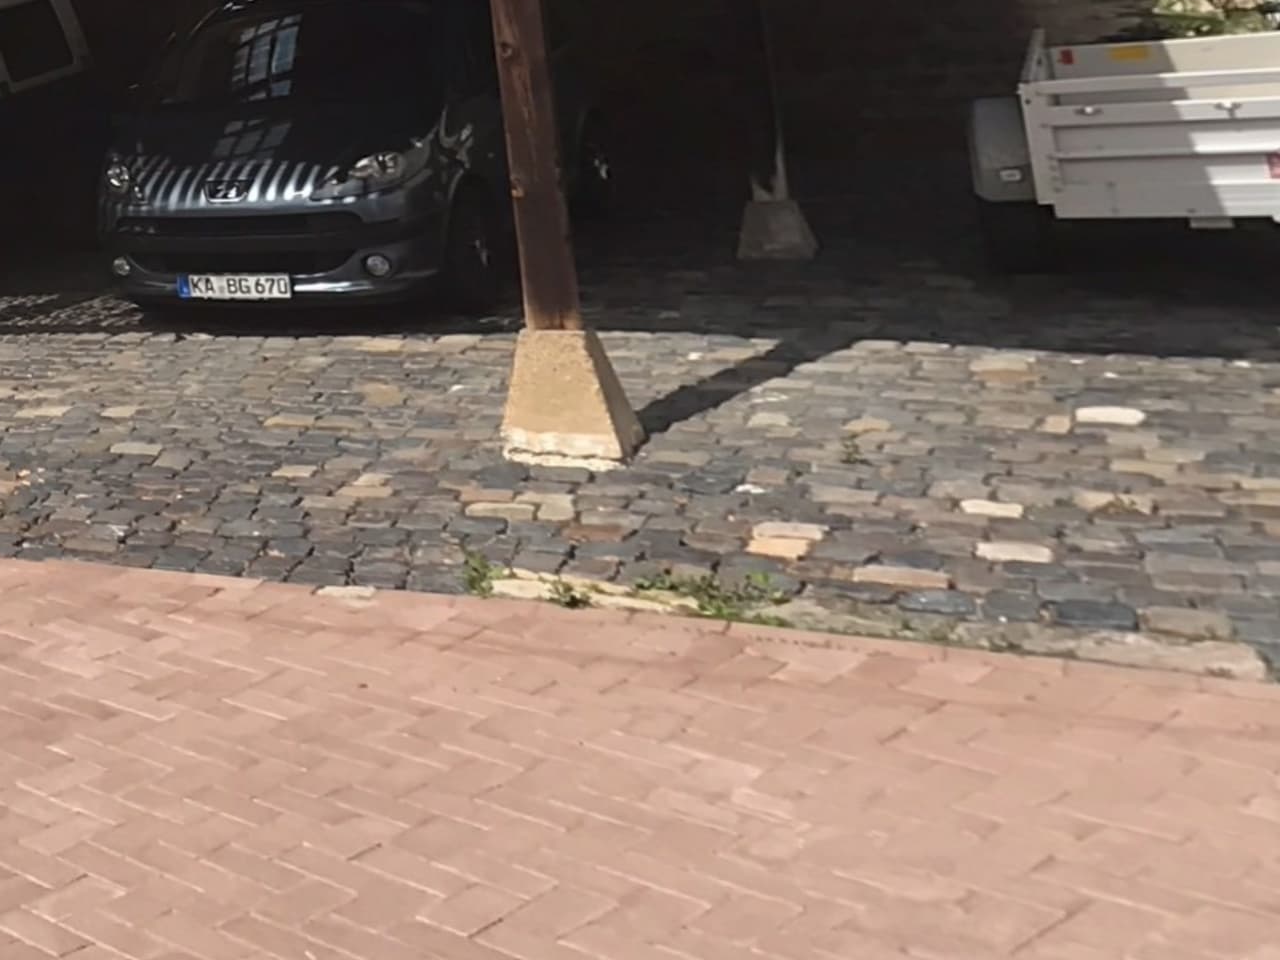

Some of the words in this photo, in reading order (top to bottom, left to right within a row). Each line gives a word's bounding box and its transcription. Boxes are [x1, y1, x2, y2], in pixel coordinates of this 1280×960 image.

[190, 277, 214, 294] KA
[226, 277, 251, 294] BG
[255, 277, 288, 294] 670
